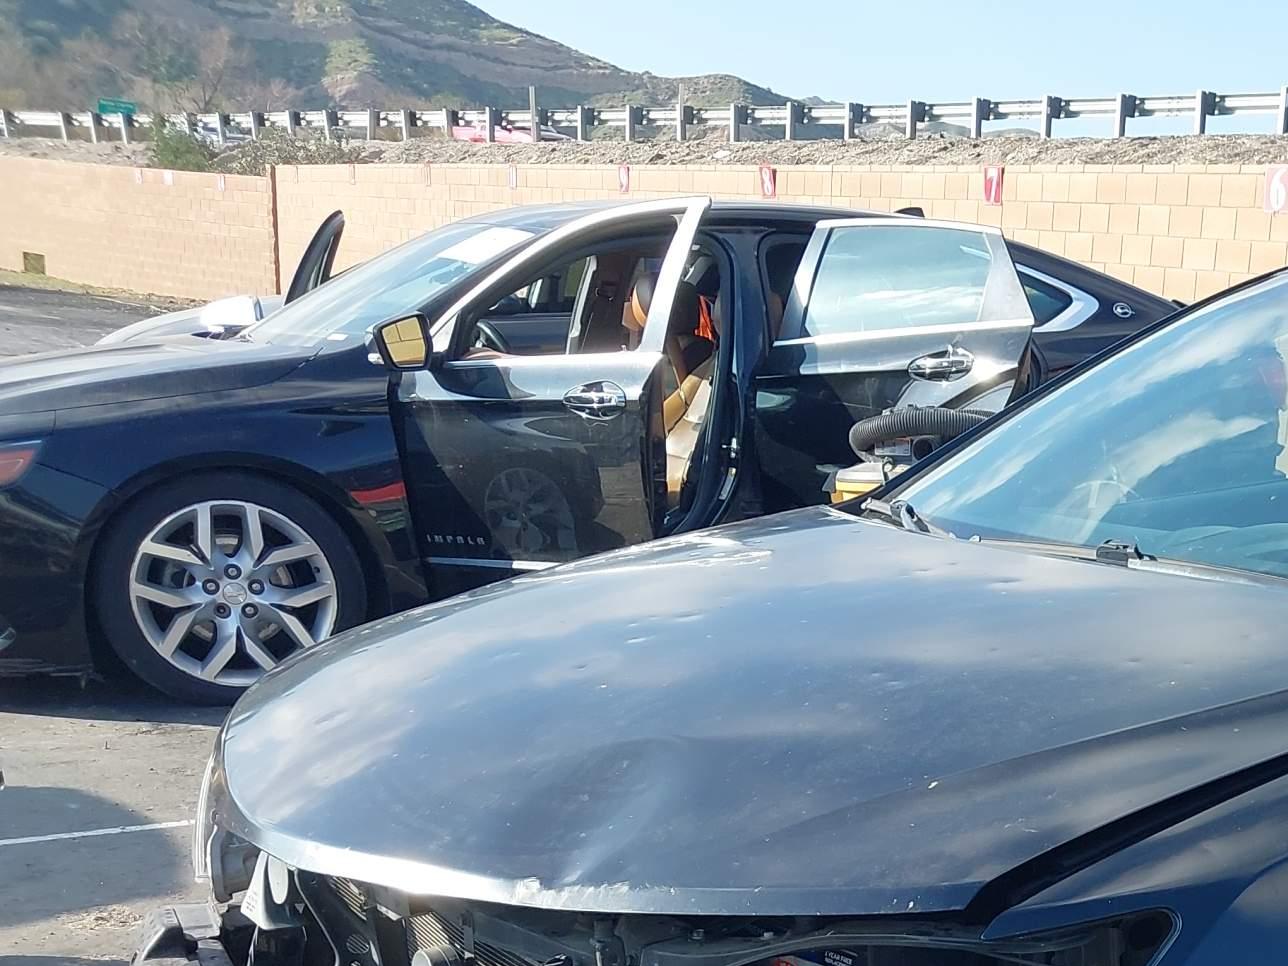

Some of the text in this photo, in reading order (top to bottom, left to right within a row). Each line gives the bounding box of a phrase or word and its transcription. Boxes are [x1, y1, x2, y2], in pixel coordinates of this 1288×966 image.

[761, 167, 772, 196] 8
[986, 167, 999, 203] 7
[1269, 168, 1288, 210] 6
[426, 533, 486, 546] IMPALA
